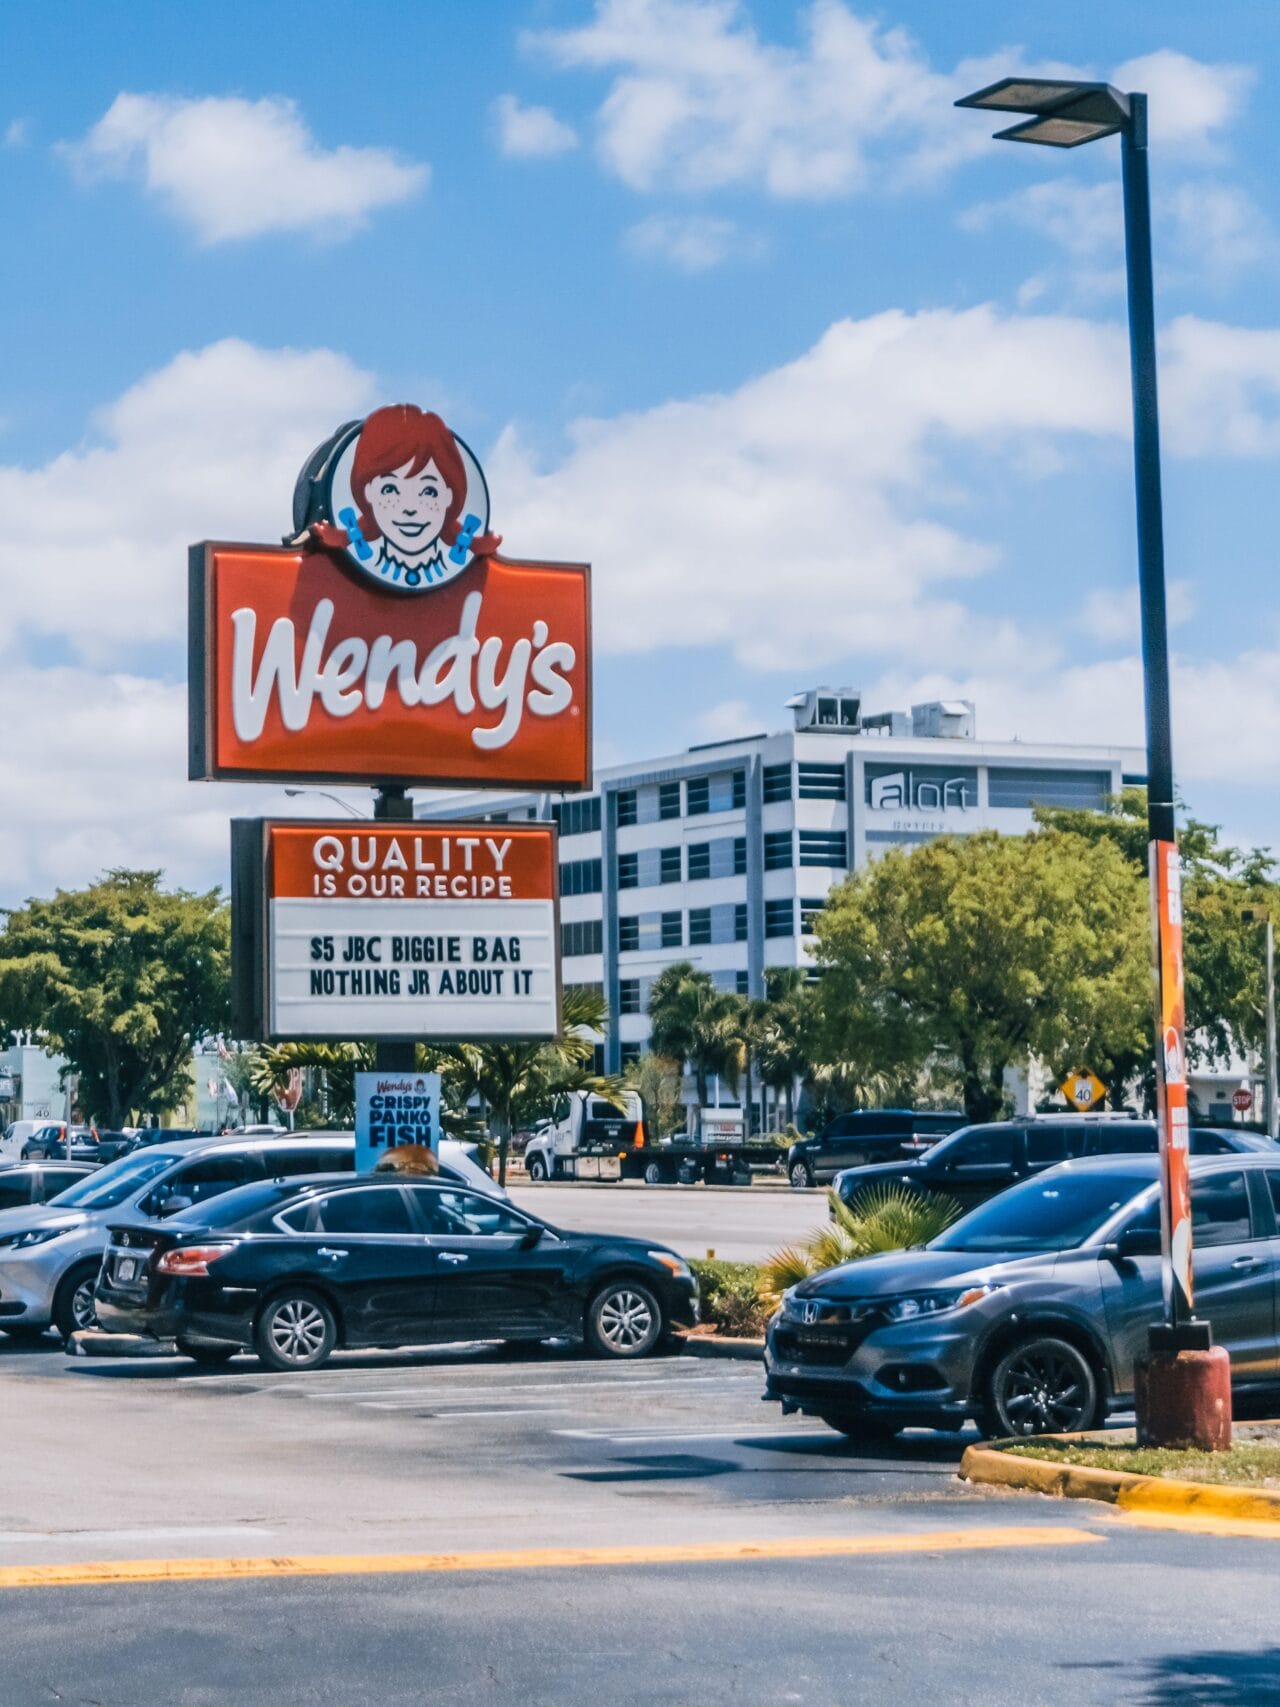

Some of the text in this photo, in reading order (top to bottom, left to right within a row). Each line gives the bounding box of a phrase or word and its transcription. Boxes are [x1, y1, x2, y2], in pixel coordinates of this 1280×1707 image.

[230, 590, 577, 750] Wendy's
[870, 770, 970, 812] aloft
[312, 835, 513, 872] QUALITY
[313, 874, 513, 897] IS OUR RECIPE
[342, 936, 382, 962] JBC
[392, 936, 461, 962] BIGGIE
[472, 936, 521, 962] BAG
[310, 969, 533, 995] NOTHING JR ABOUT IT
[369, 1095, 432, 1110] CRISPY
[1075, 1089, 1092, 1102] 40
[1232, 1095, 1252, 1106] STOP
[35, 1109, 50, 1118] 40
[369, 1110, 432, 1126] PANKO
[369, 1125, 432, 1148] FISH
